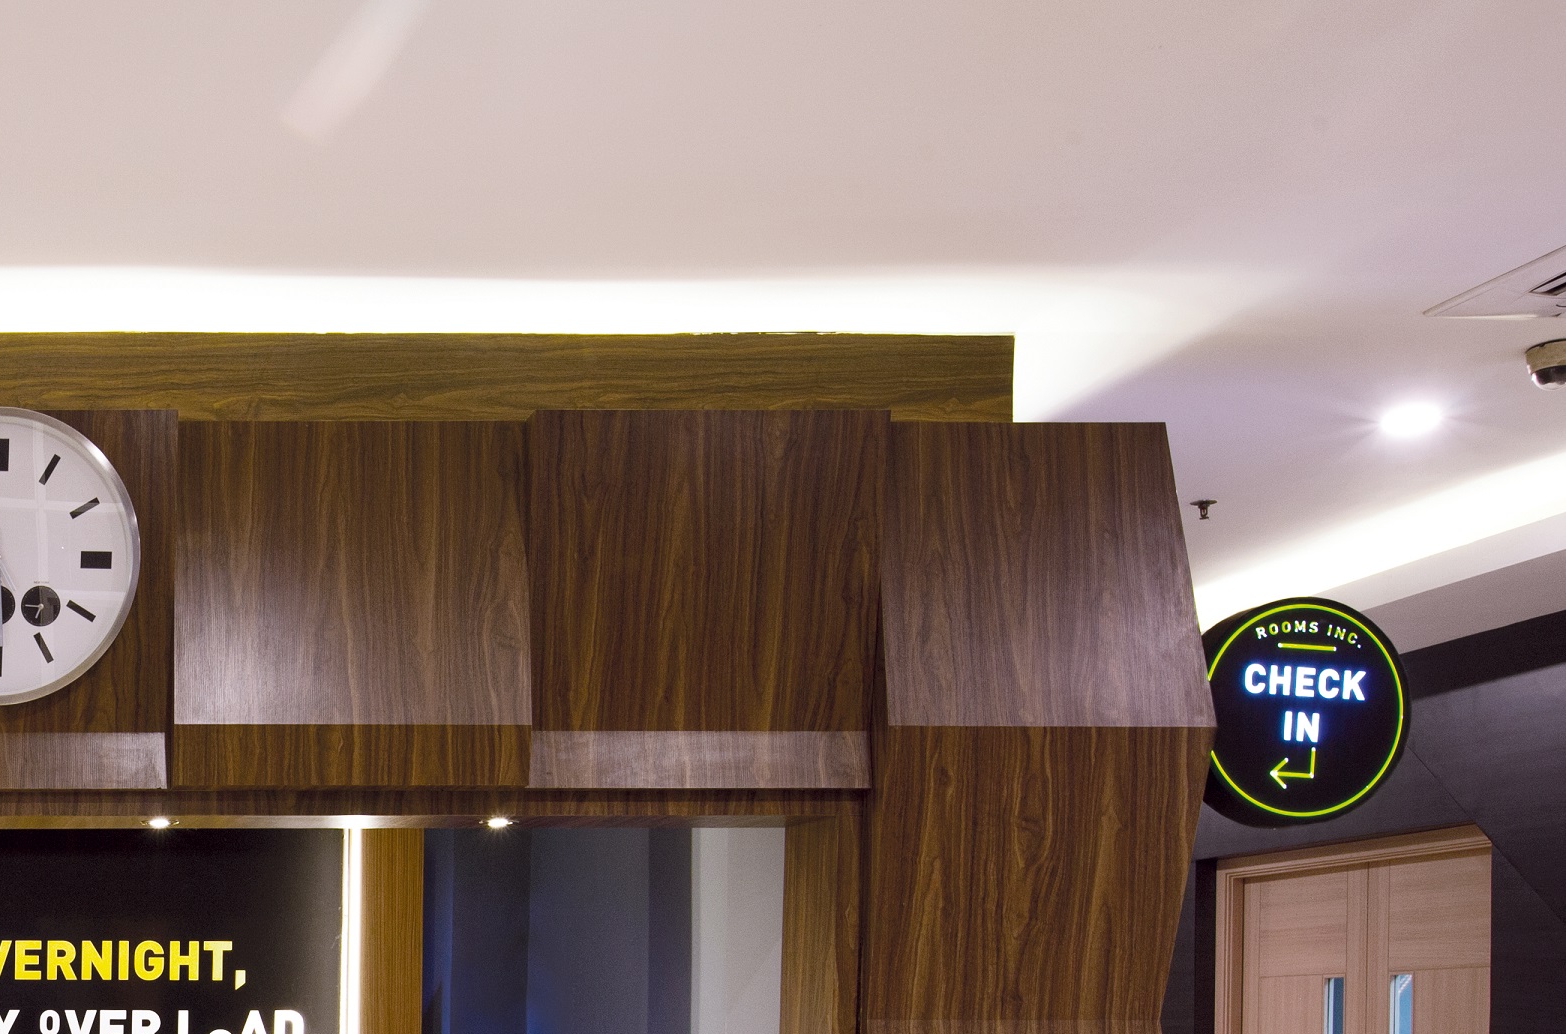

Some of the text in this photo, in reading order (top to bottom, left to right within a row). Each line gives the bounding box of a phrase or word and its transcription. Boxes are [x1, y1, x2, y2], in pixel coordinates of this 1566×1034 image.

[1255, 619, 1362, 649] ROOMS INC.
[1244, 663, 1367, 701] CHECK
[1283, 710, 1321, 743] IN
